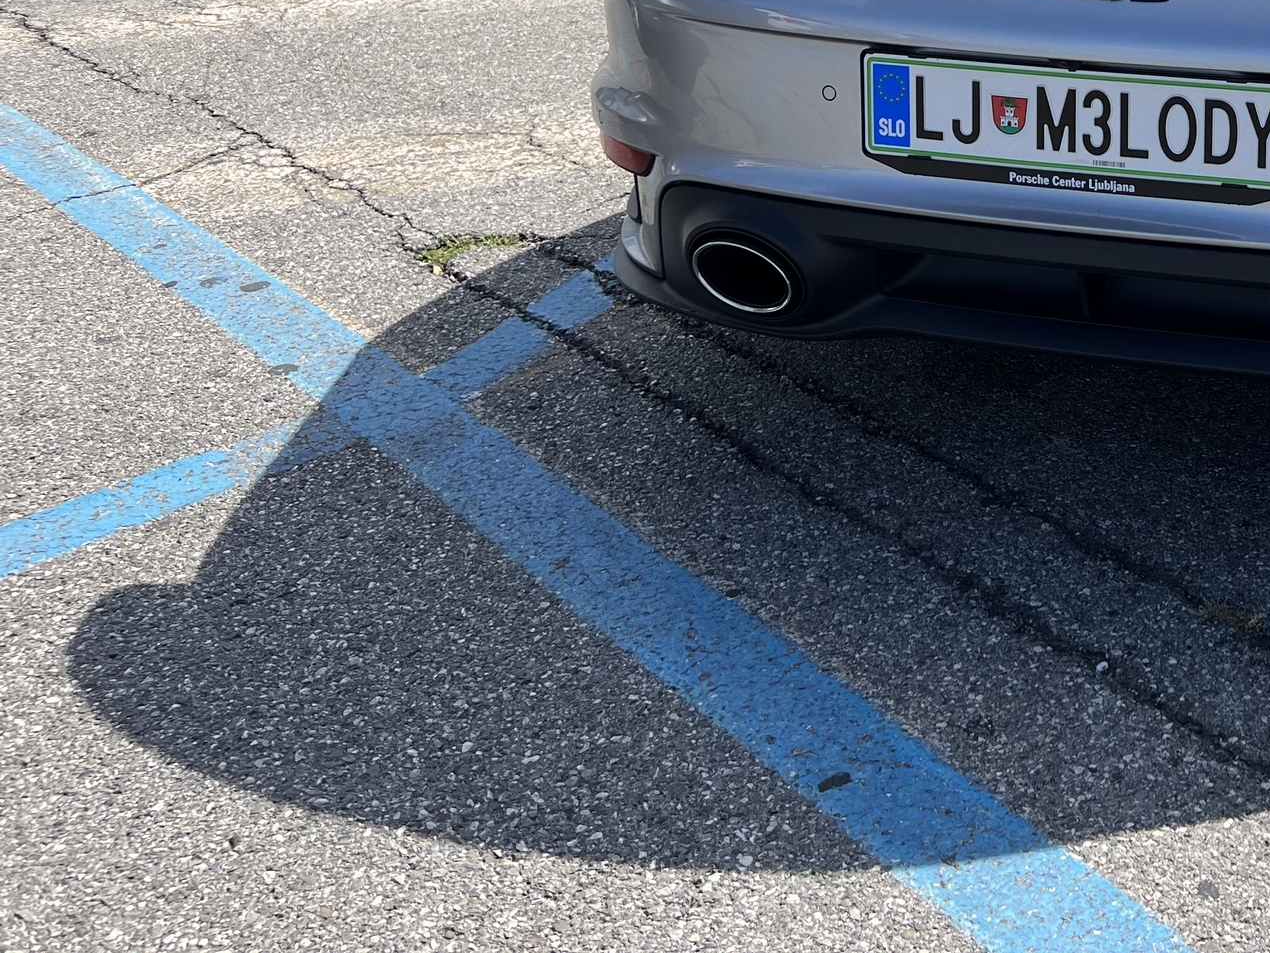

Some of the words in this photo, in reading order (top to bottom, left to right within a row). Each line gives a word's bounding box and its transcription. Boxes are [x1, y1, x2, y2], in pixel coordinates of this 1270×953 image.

[915, 75, 980, 145] LJ
[878, 117, 906, 138] SLO
[1009, 171, 1050, 186] Porsche
[1052, 175, 1086, 189] Center
[1088, 178, 1135, 193] Ljubljana
